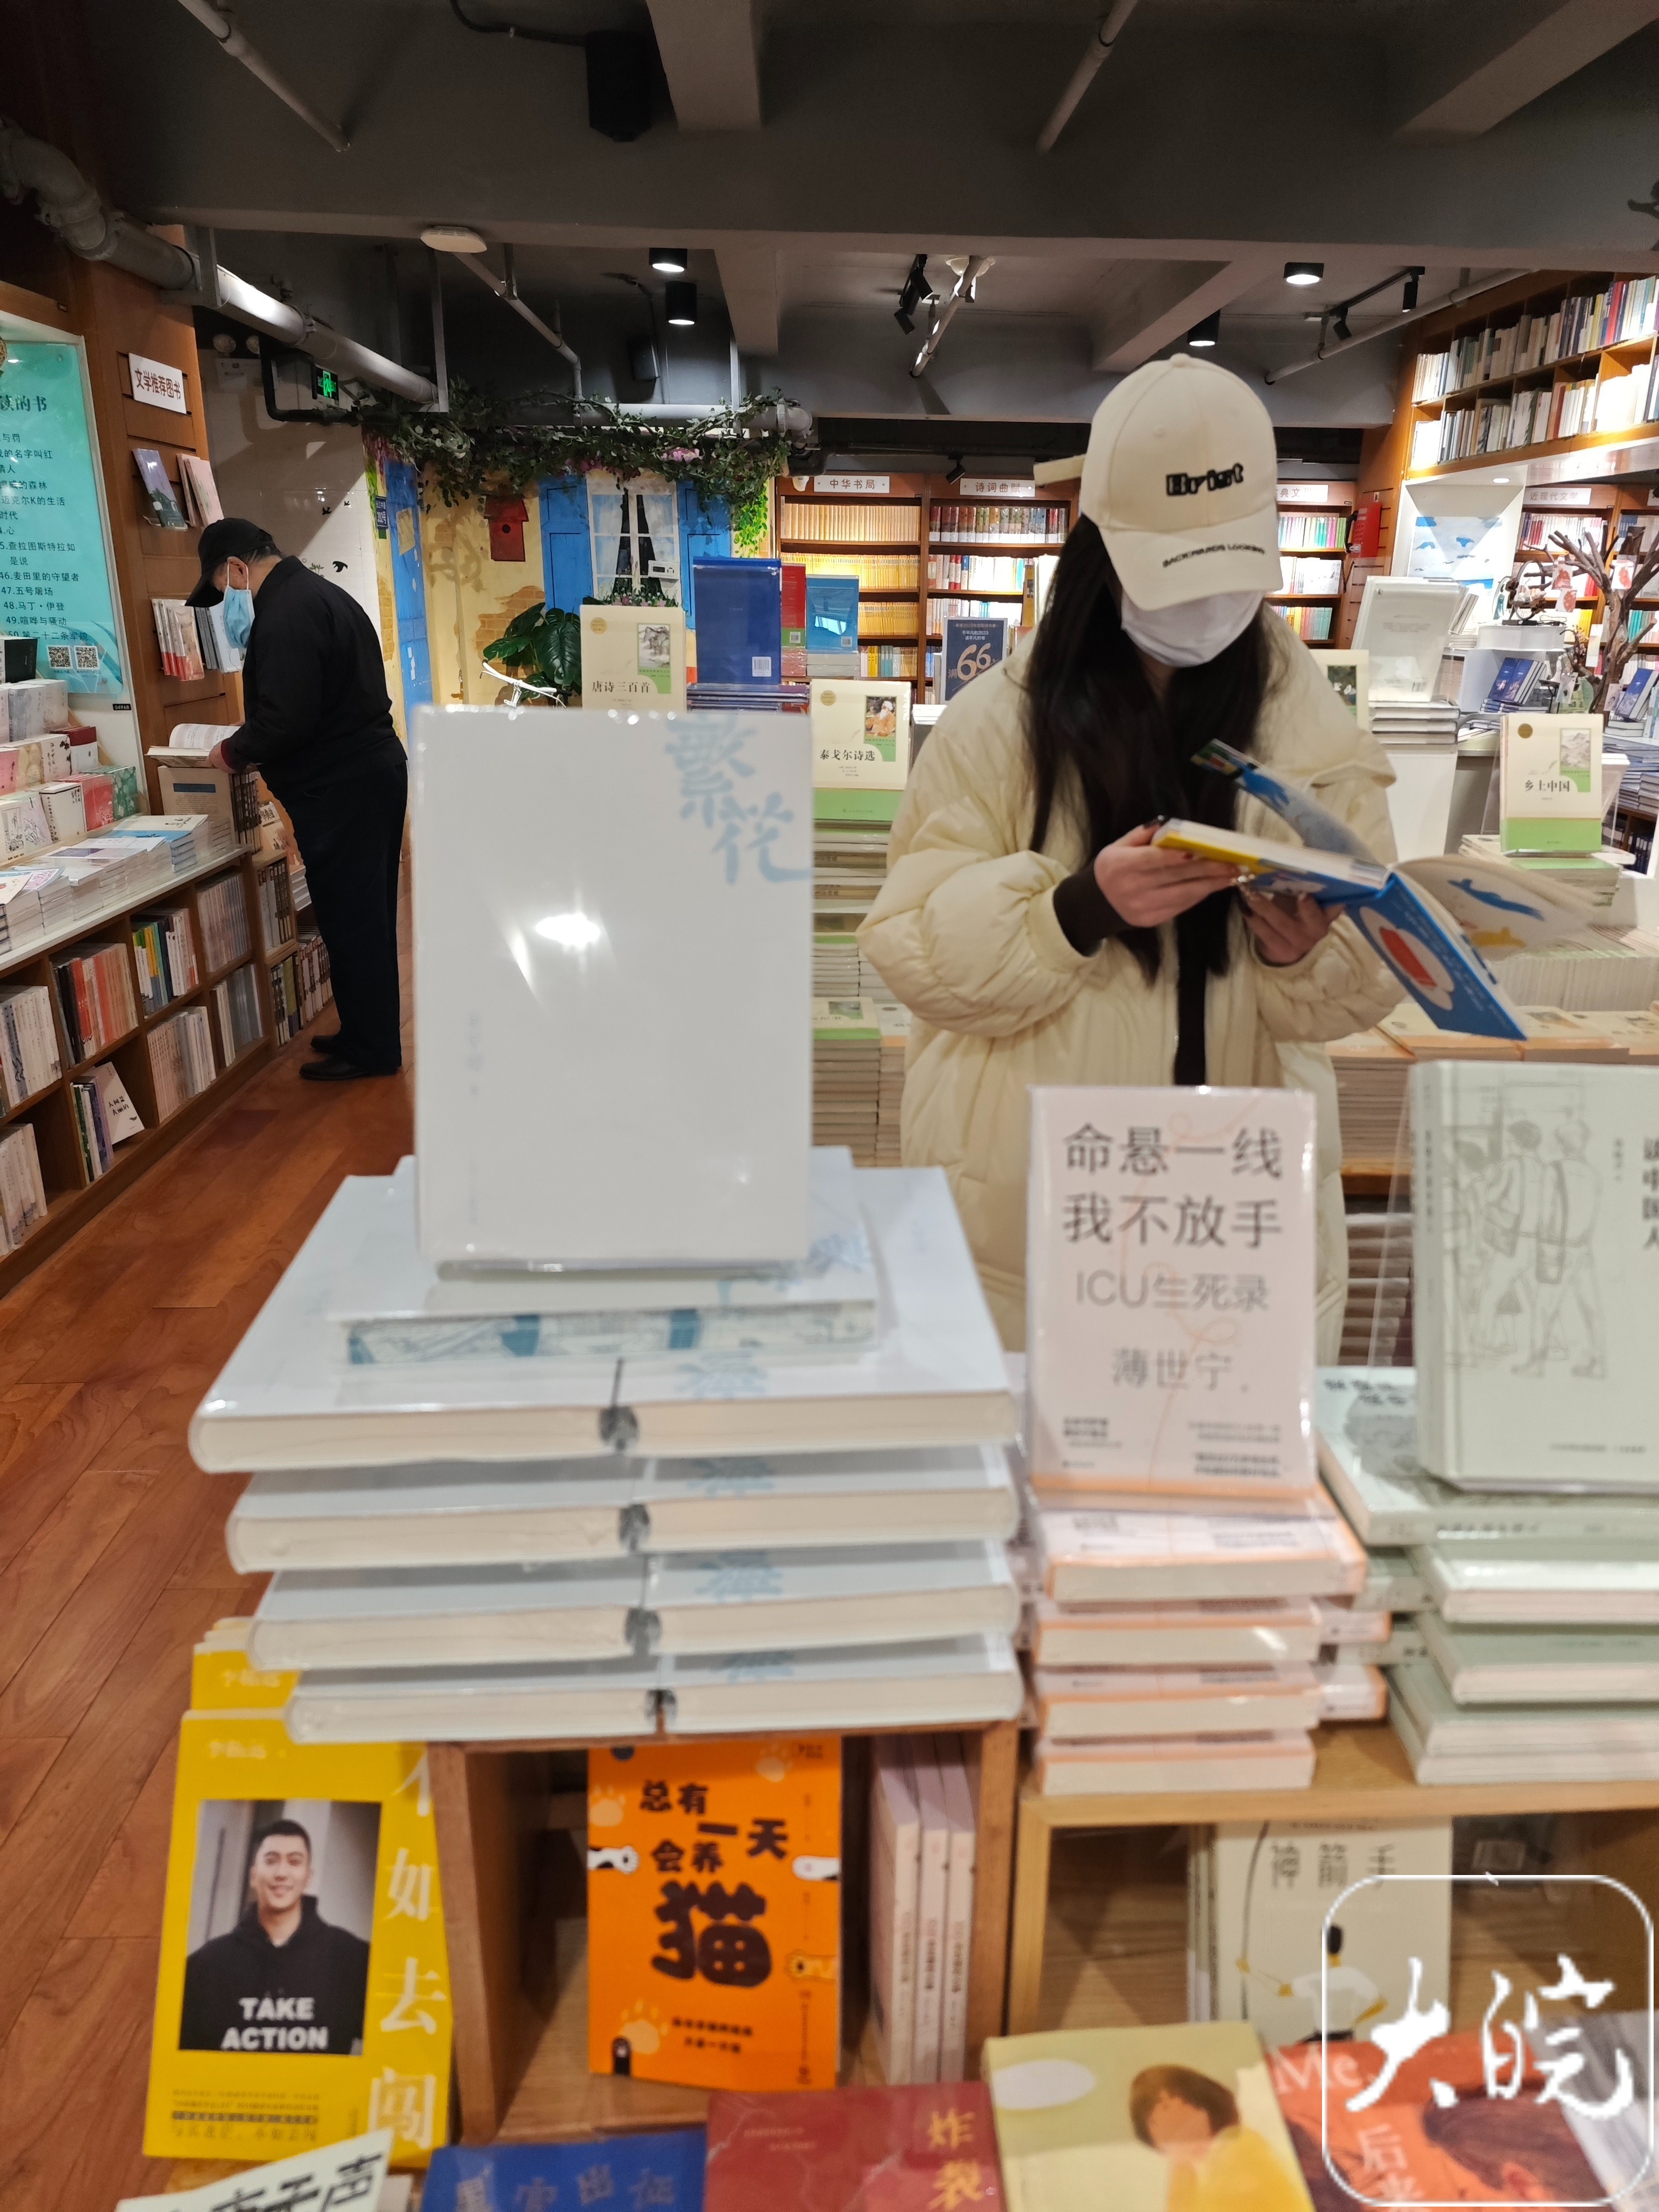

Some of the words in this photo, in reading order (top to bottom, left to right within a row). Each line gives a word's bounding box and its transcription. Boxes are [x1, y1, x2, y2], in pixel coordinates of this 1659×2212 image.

[134, 368, 181, 400] 文学推荐图书
[830, 479, 875, 489] 中华书局
[975, 482, 1021, 493] 诗词曲赋
[1530, 491, 1579, 501] 近现代文学
[10, 556, 29, 566] 是说
[1, 586, 53, 596] 47.五号屠场
[6, 616, 67, 626] 49.喧哗与骚动
[592, 680, 649, 693] 唐诗三百首
[820, 749, 875, 761] 泰戈尔诗选
[1524, 780, 1570, 792] 乡土中国
[1063, 1122, 1283, 1179] 命悬一线
[1063, 1192, 1283, 1247] 我不放手
[1077, 1269, 1270, 1311] ICU生死录
[1114, 1349, 1232, 1391] 薄世宁
[640, 1780, 709, 1816] 总有
[697, 1818, 788, 1860] 一天
[651, 1839, 724, 1874] 会养
[651, 1879, 772, 1989] 猫
[238, 1997, 315, 2021] TAKE
[221, 2026, 329, 2051] ACTION
